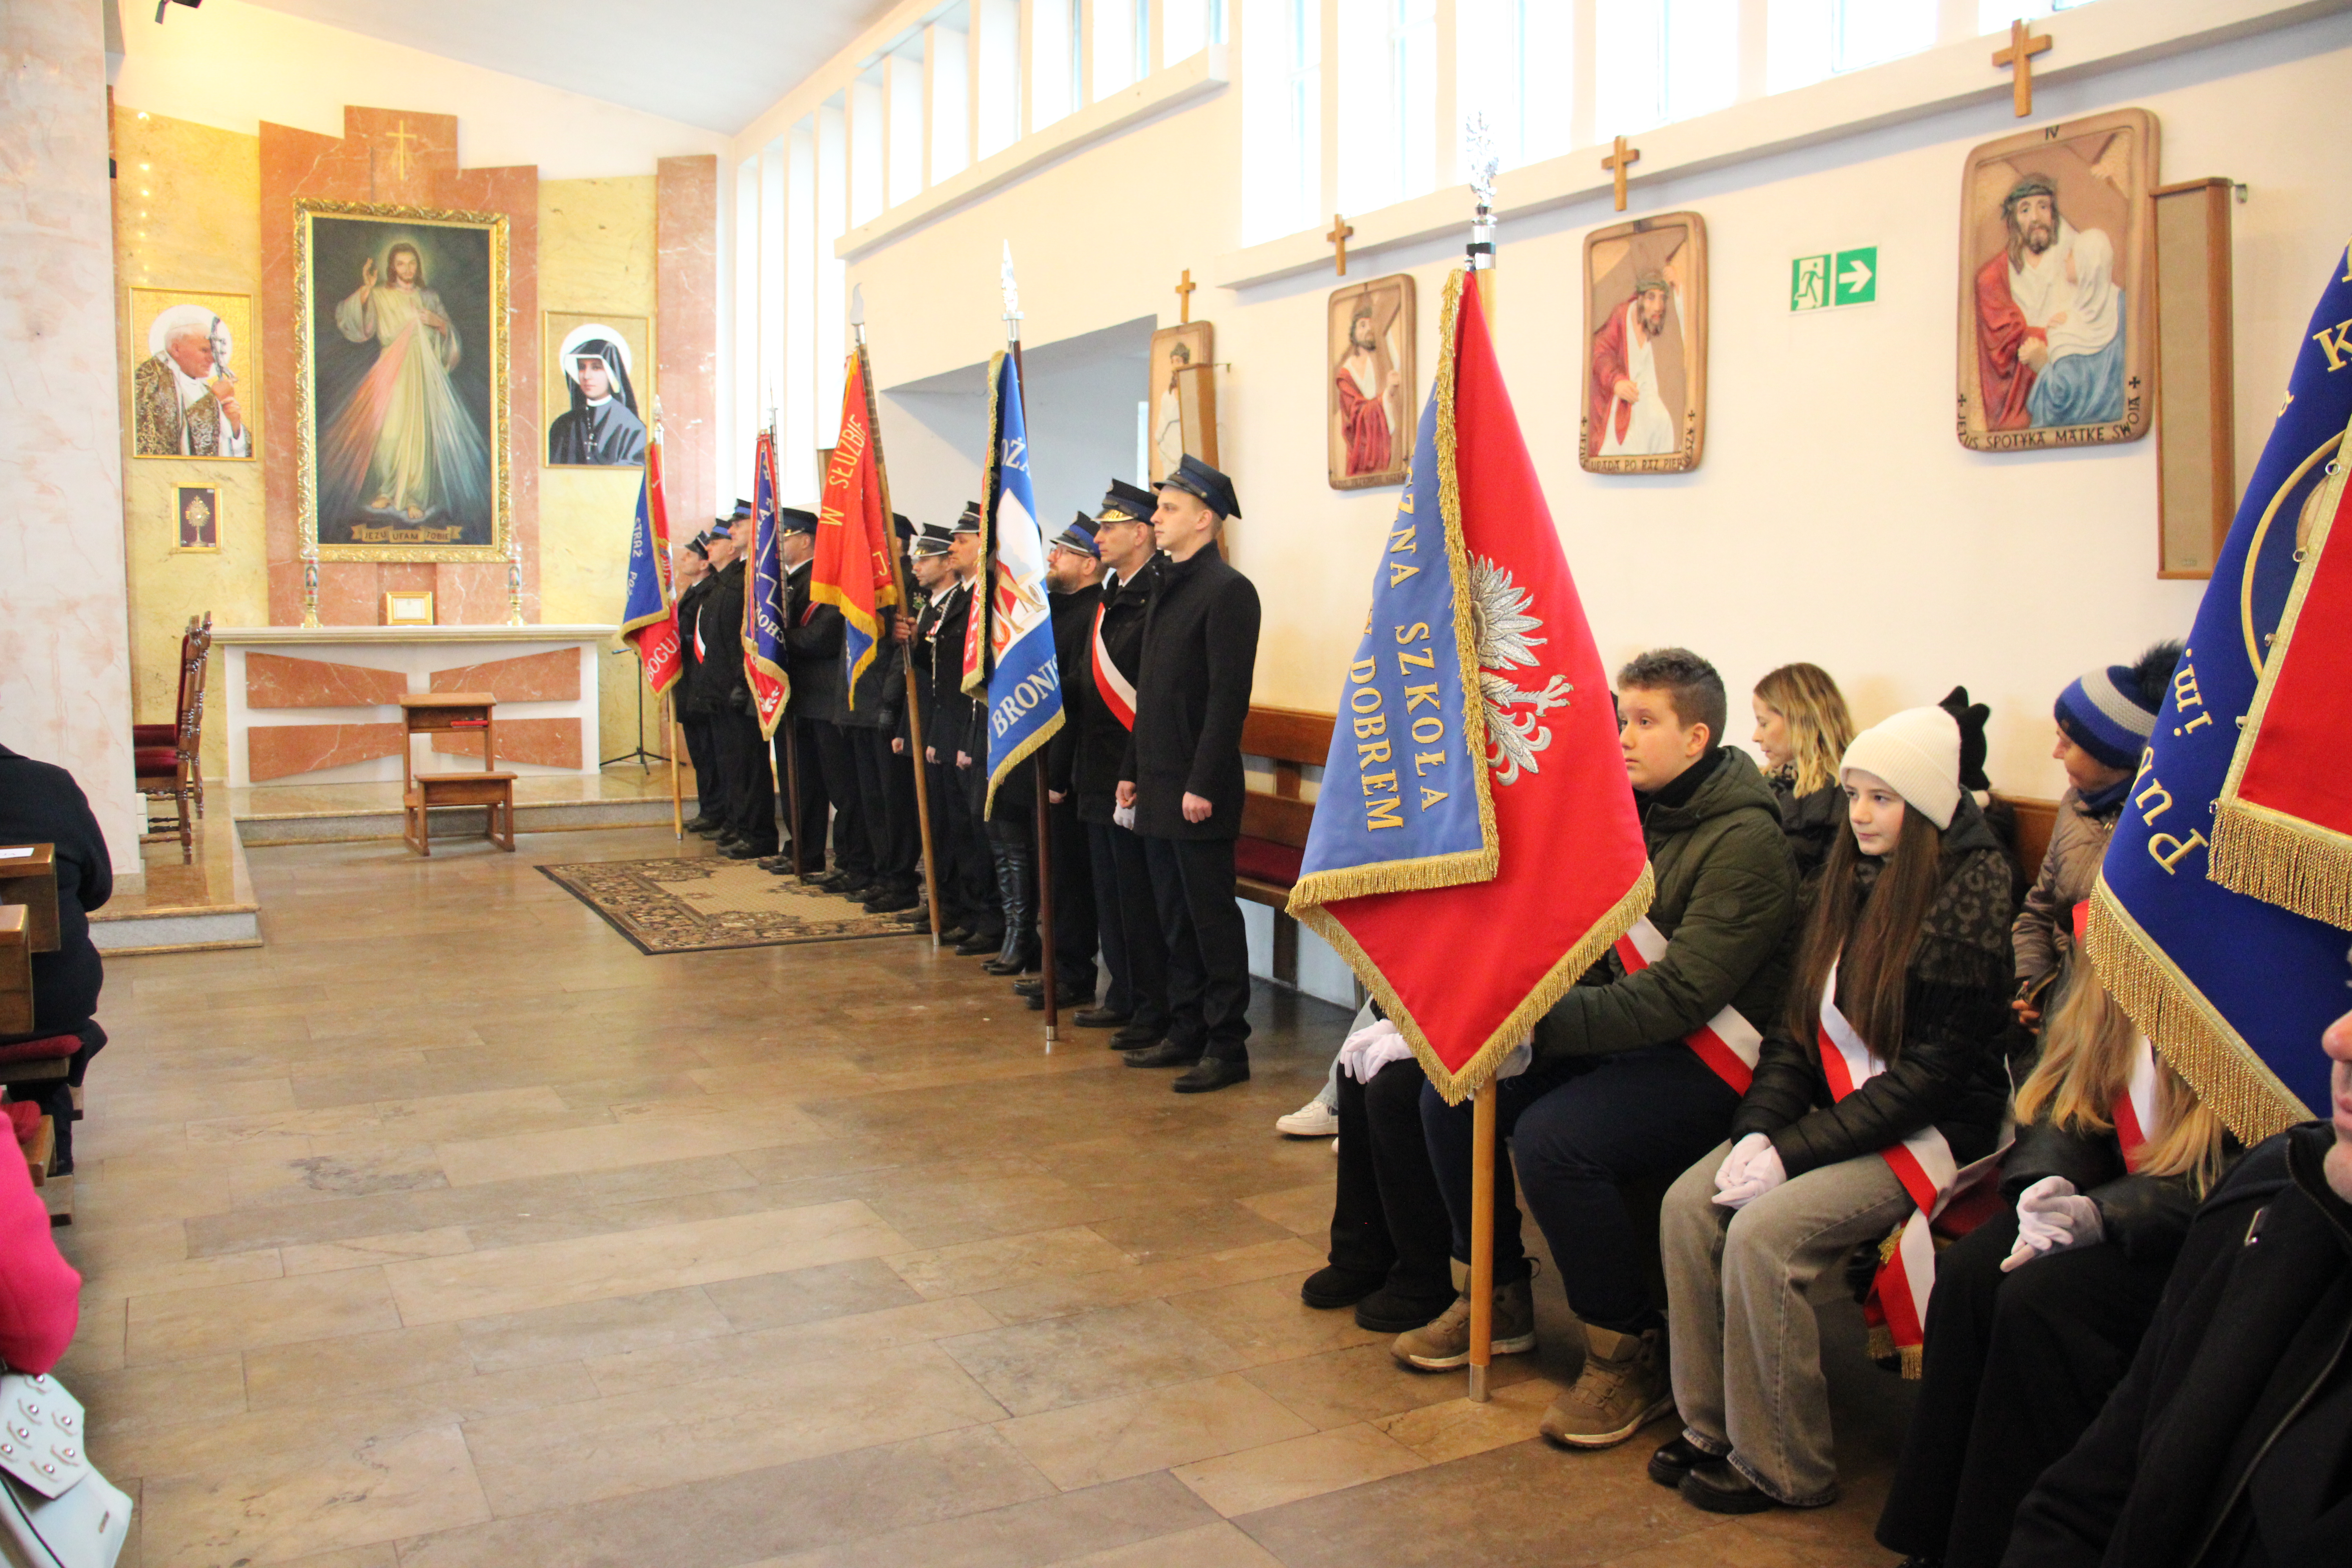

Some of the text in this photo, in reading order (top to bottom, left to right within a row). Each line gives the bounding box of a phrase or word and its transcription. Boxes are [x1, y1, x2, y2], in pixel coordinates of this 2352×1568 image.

[2045, 125, 2060, 140] IV
[1625, 460, 1637, 470] PO
[819, 506, 845, 526] W
[1390, 447, 1448, 812] CZNA SZKOŁA
[645, 630, 678, 682] BOGU
[1350, 655, 1404, 833] DOBREM
